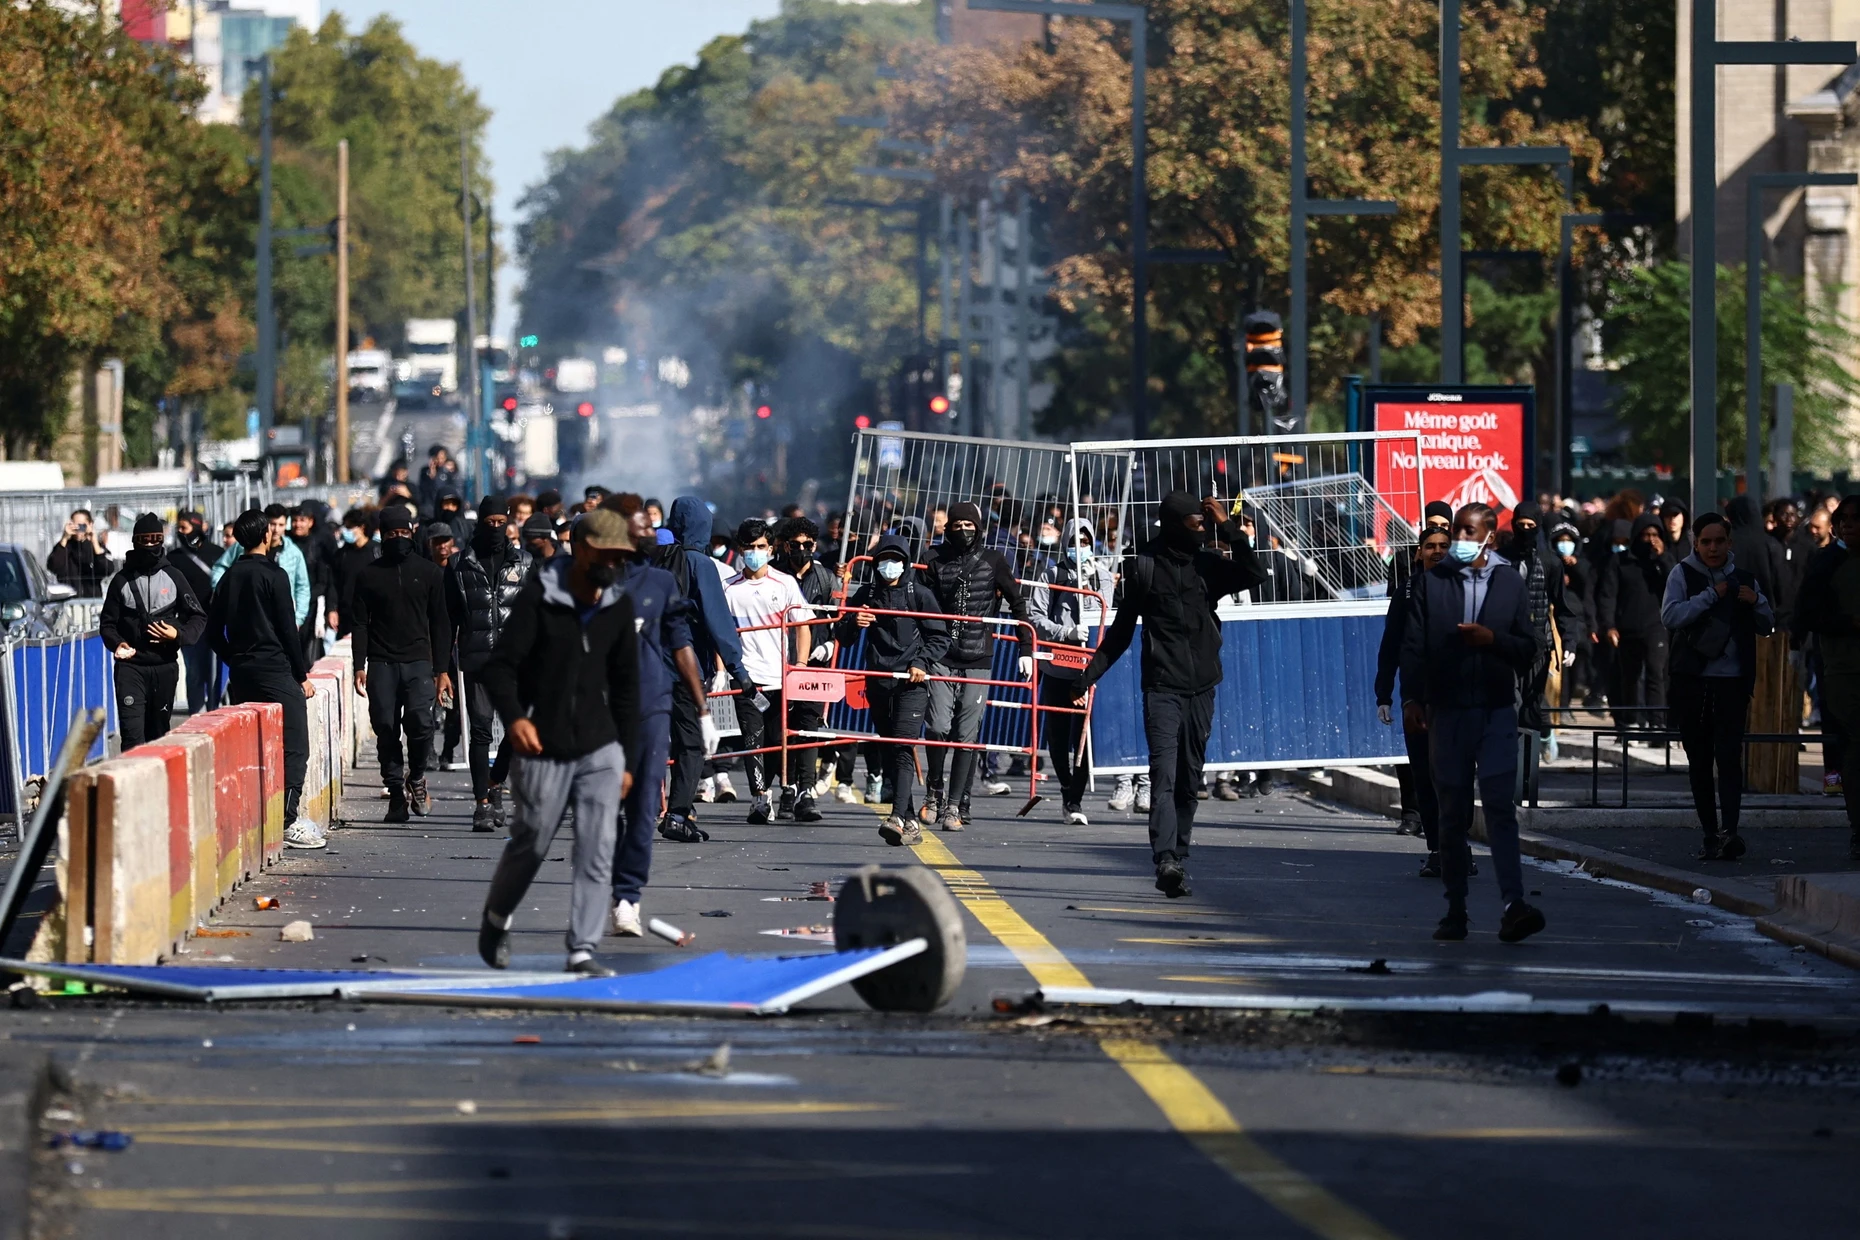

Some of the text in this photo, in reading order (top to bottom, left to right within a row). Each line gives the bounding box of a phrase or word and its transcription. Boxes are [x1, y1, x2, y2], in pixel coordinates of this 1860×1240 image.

[1404, 410, 1498, 432] Même goût
[1467, 451, 1509, 470] look.
[798, 682, 819, 691] ACM
